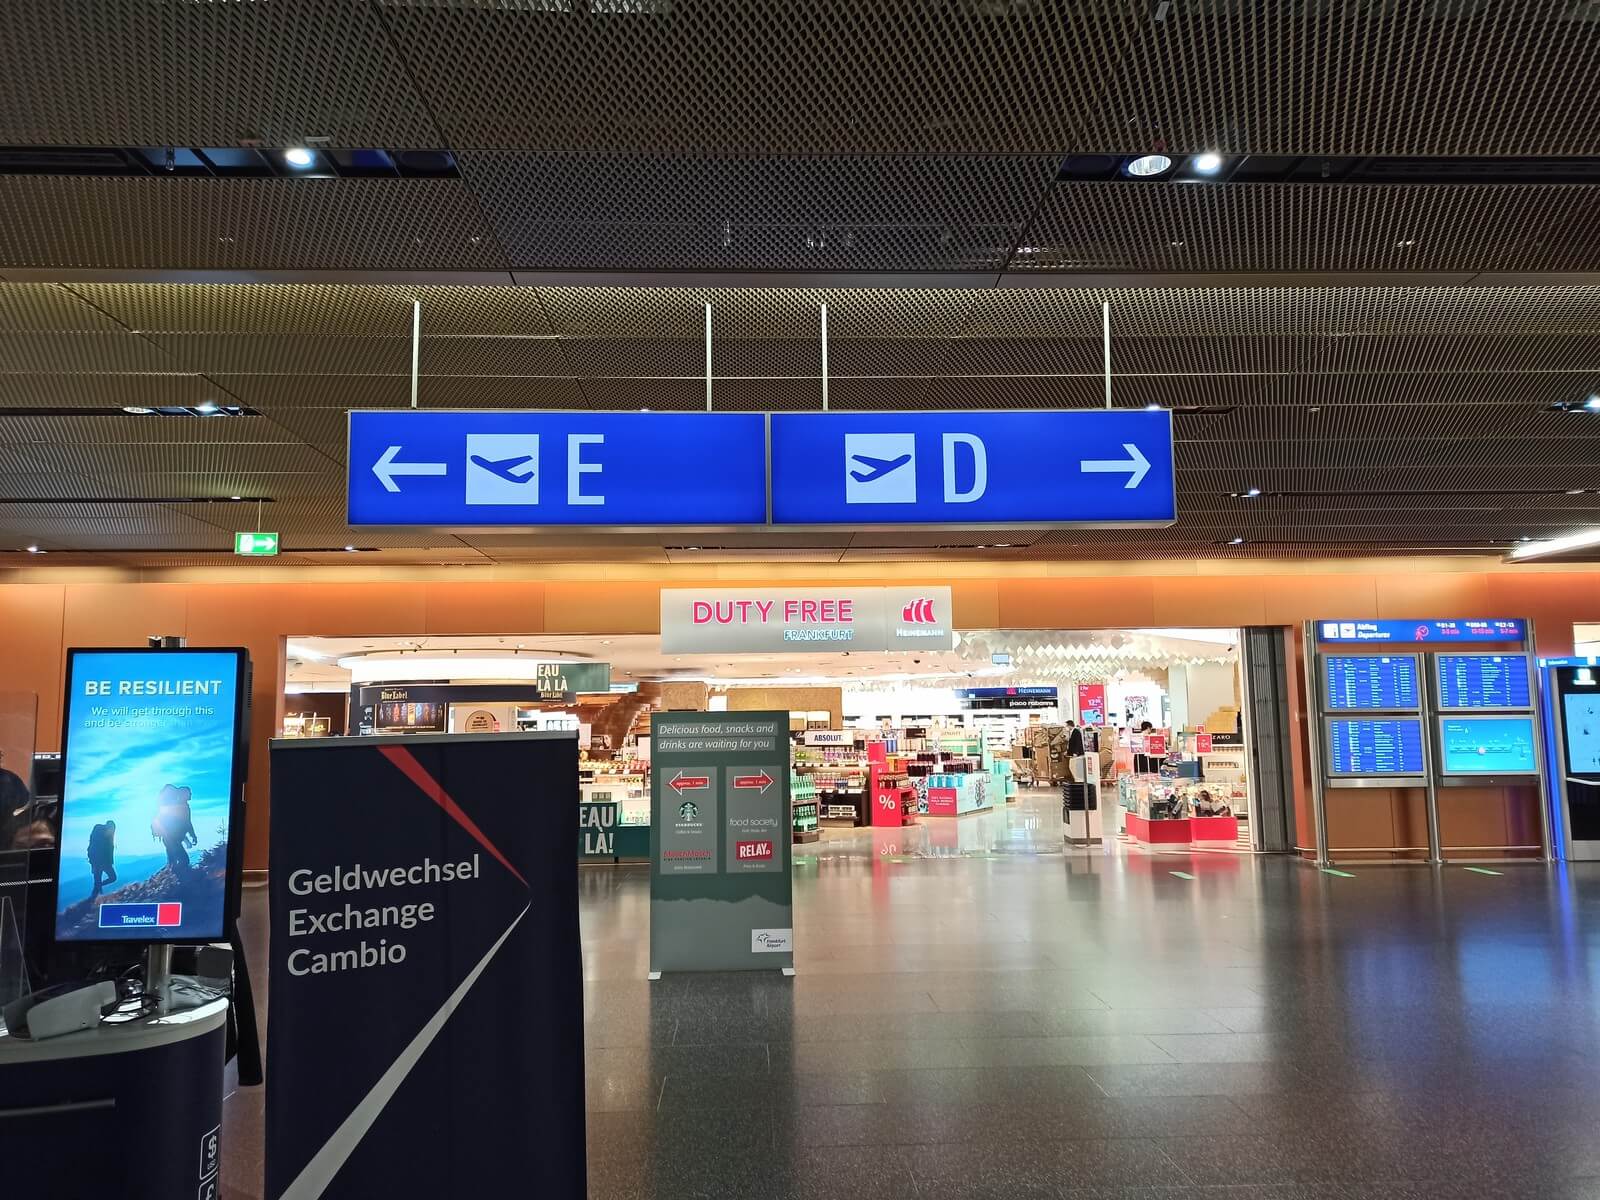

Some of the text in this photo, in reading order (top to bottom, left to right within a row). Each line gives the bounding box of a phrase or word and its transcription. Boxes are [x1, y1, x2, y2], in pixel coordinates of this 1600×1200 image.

[567, 433, 605, 506] E
[942, 432, 989, 504] D
[692, 599, 853, 624] DUTY FREE
[783, 629, 854, 640] FRANKFURT
[538, 664, 560, 677] EAU
[85, 680, 222, 696] BE RESILIENT
[537, 676, 568, 691] LÀ LÀ
[91, 705, 214, 718] We will get through this
[84, 719, 105, 728] and
[107, 719, 121, 728] be
[659, 723, 774, 735] Delicious food, snacks and
[659, 739, 769, 750] drinks are waiting for you
[878, 794, 896, 810] %
[580, 806, 614, 828] EAU
[729, 818, 778, 827] food society
[740, 843, 768, 858] RELAY
[288, 853, 479, 896] Geldwechsel
[121, 915, 155, 924] Travelex
[289, 902, 435, 937] Exchange
[287, 938, 407, 976] Cambio
